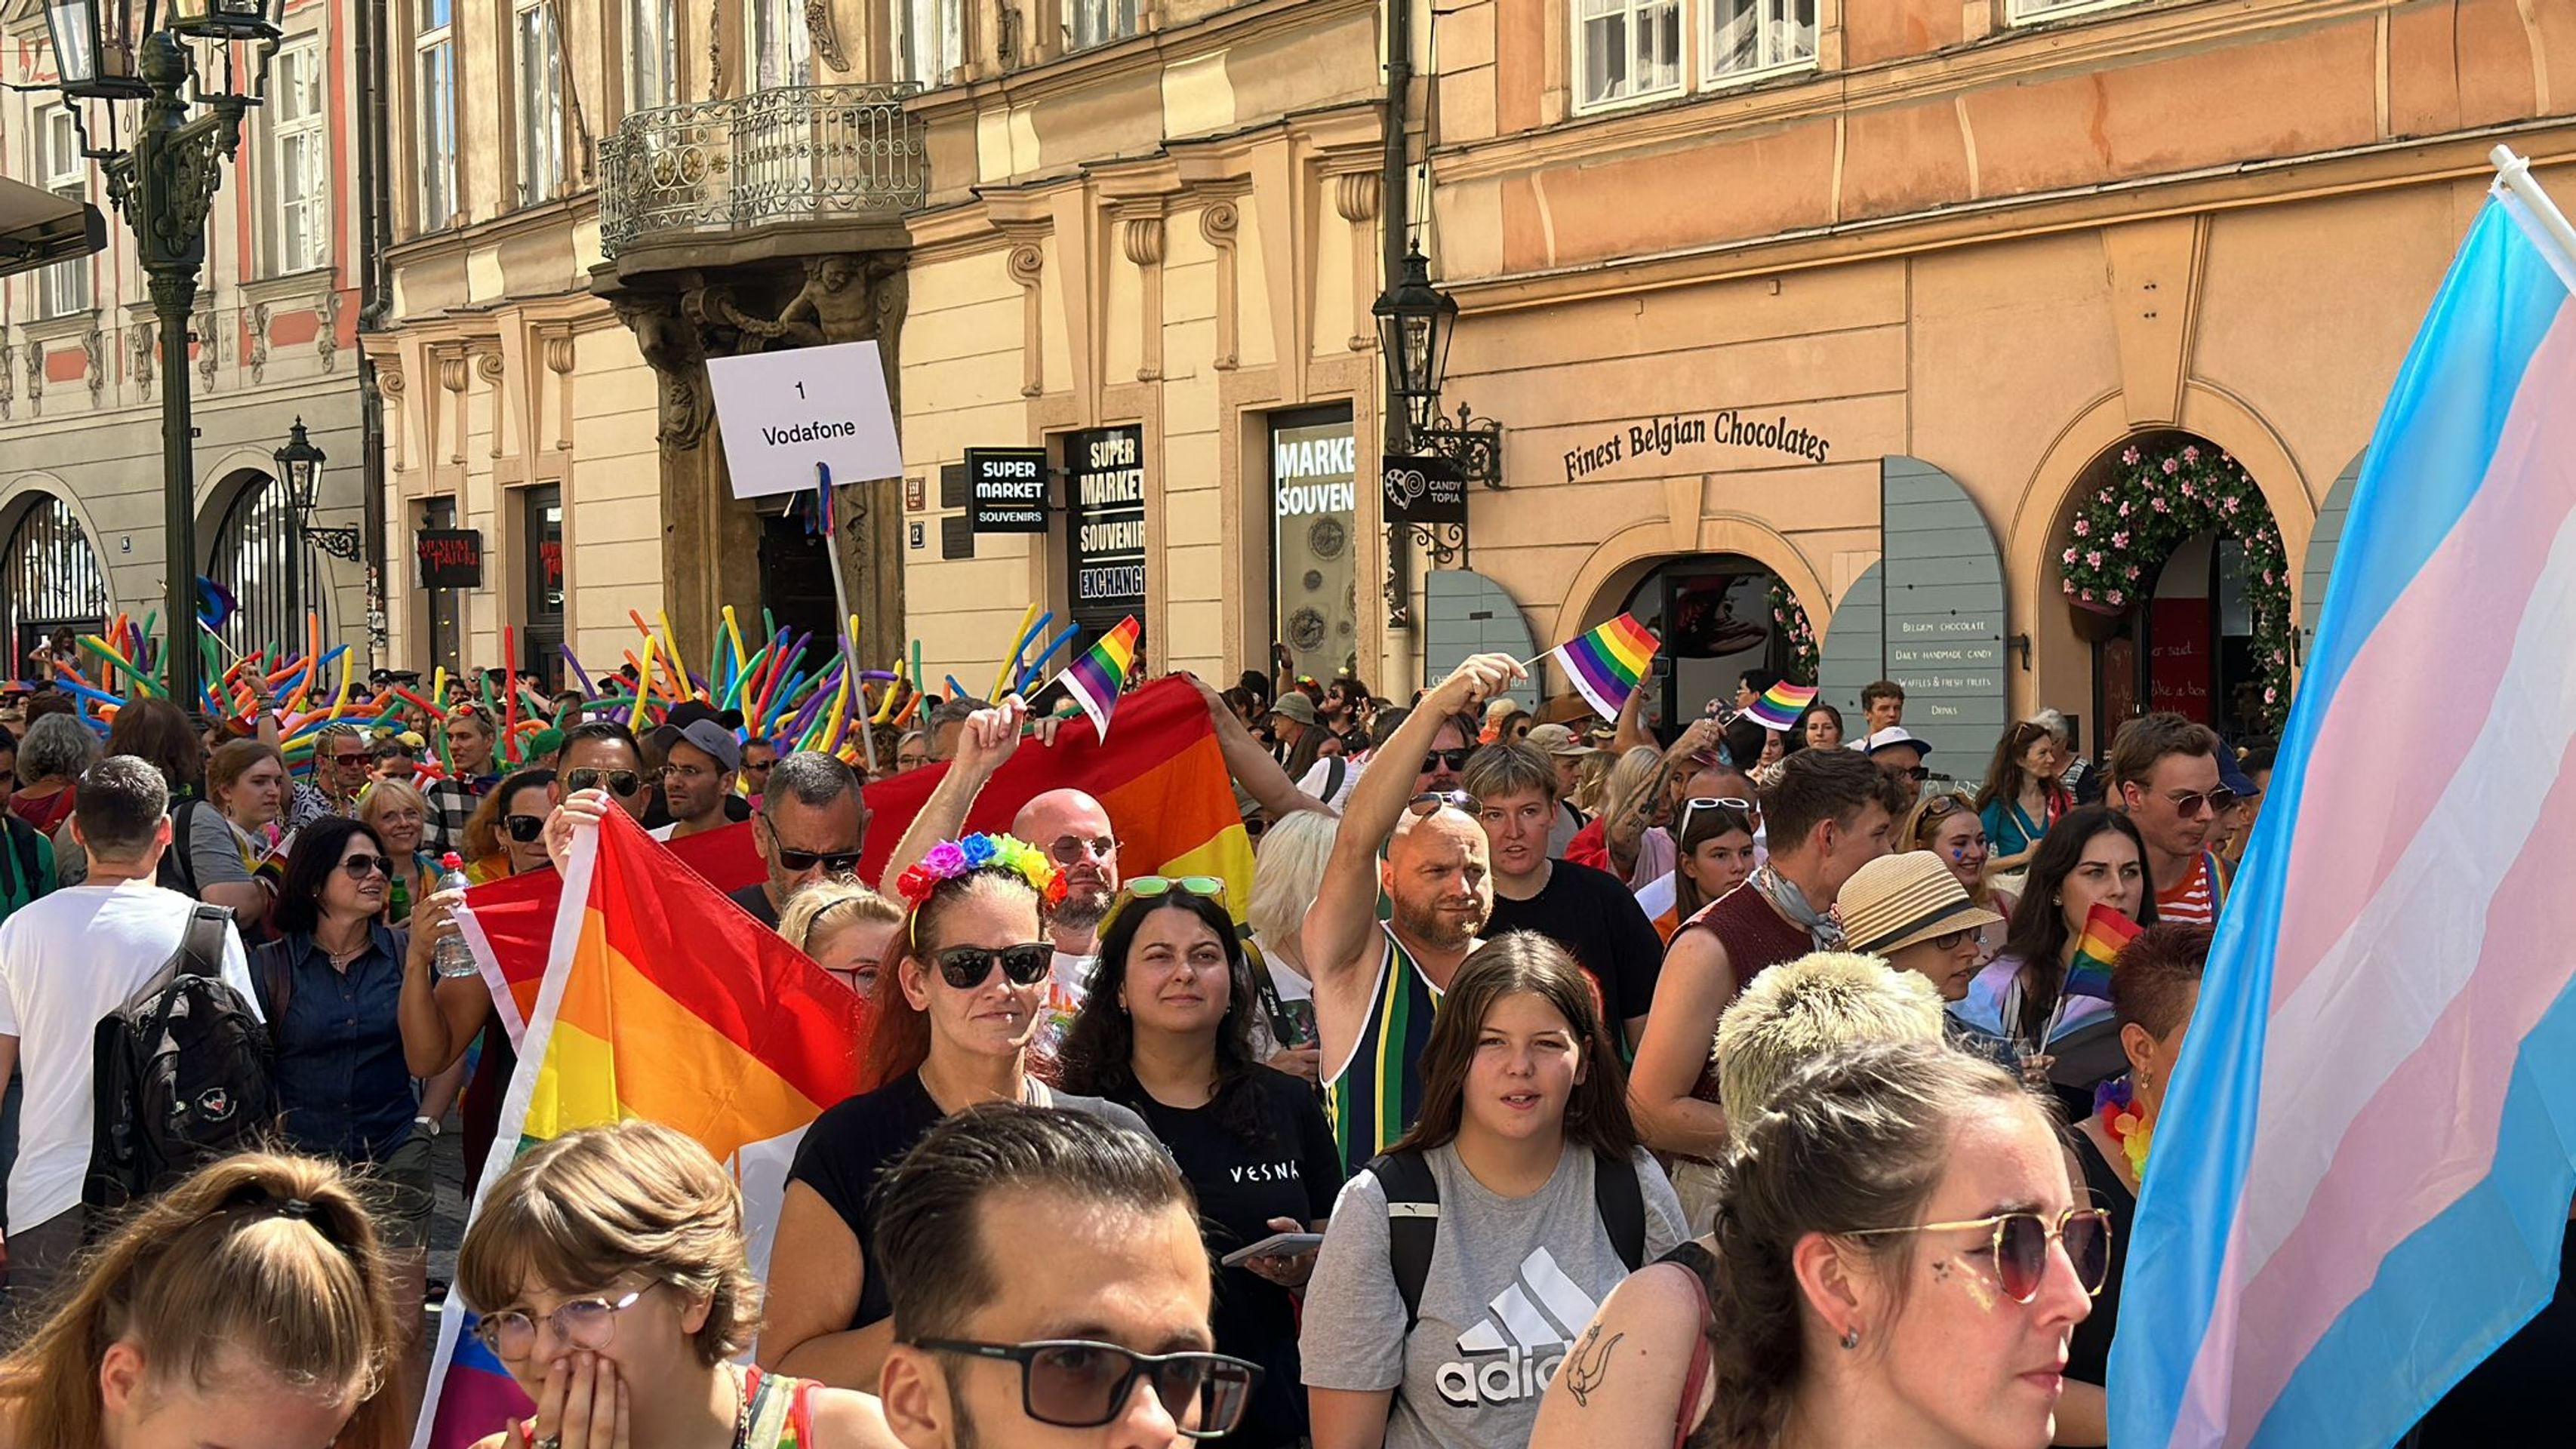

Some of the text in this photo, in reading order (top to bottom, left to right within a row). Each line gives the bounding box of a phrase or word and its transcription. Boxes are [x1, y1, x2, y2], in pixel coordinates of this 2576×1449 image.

[795, 381, 805, 399] 1
[762, 420, 856, 446] Vodafone
[1090, 438, 1136, 469] SUPER
[1563, 410, 1830, 483] Finest Belgian Chocolates
[983, 461, 1036, 478] SUPER
[976, 481, 1044, 499] MARKET
[1080, 468, 1145, 506] MARKET
[1429, 480, 1462, 491] CANDY
[1279, 481, 1356, 516] SOUVEN
[1430, 493, 1461, 503] TOPIA
[979, 511, 1042, 523] SOUVENIRS
[1940, 621, 1986, 632] CHOCOLATE
[1895, 649, 1993, 661] DAILY HANDMADE CANDY
[1898, 676, 1991, 688] WAFFLES & FRESH FRUITS
